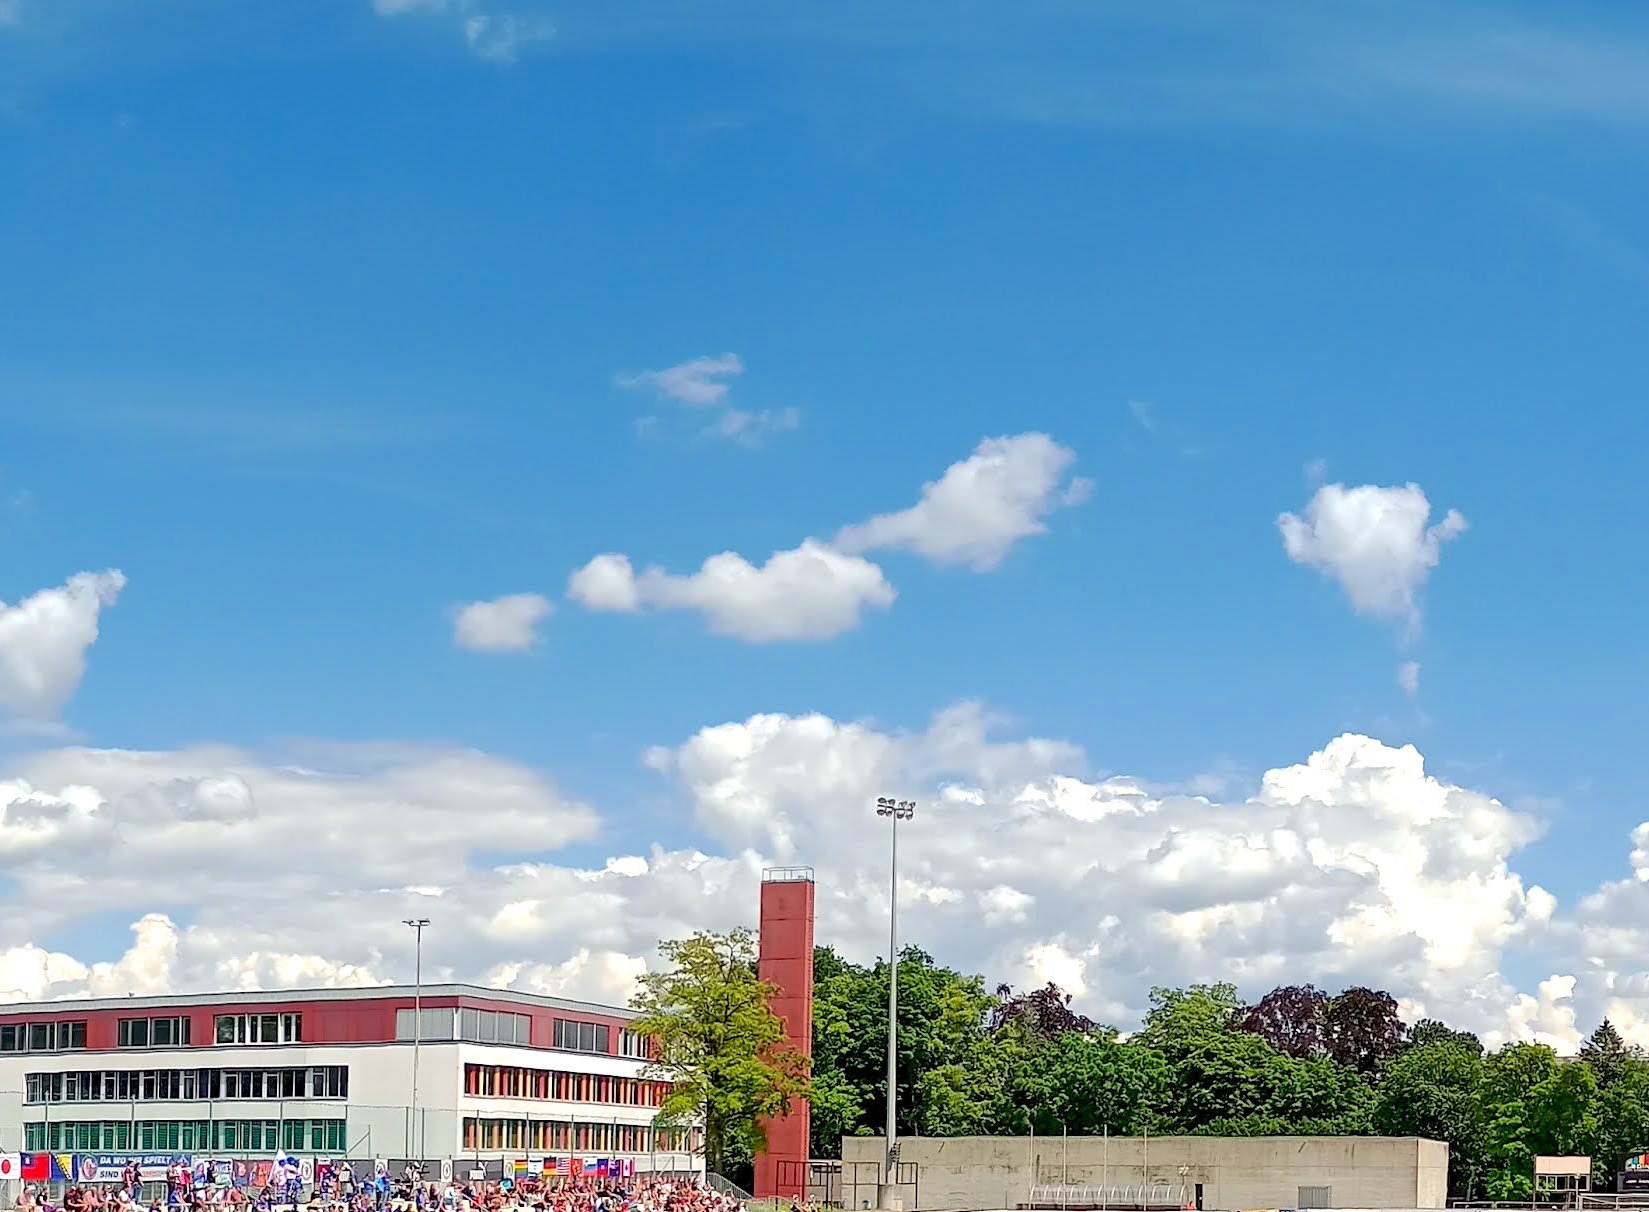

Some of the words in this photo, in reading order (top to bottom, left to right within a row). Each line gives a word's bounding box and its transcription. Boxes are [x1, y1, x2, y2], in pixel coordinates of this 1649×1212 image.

[100, 1156, 111, 1165] DA
[113, 1156, 126, 1165] WO
[143, 1155, 172, 1165] SPIELT
[100, 1170, 119, 1178] SIND
